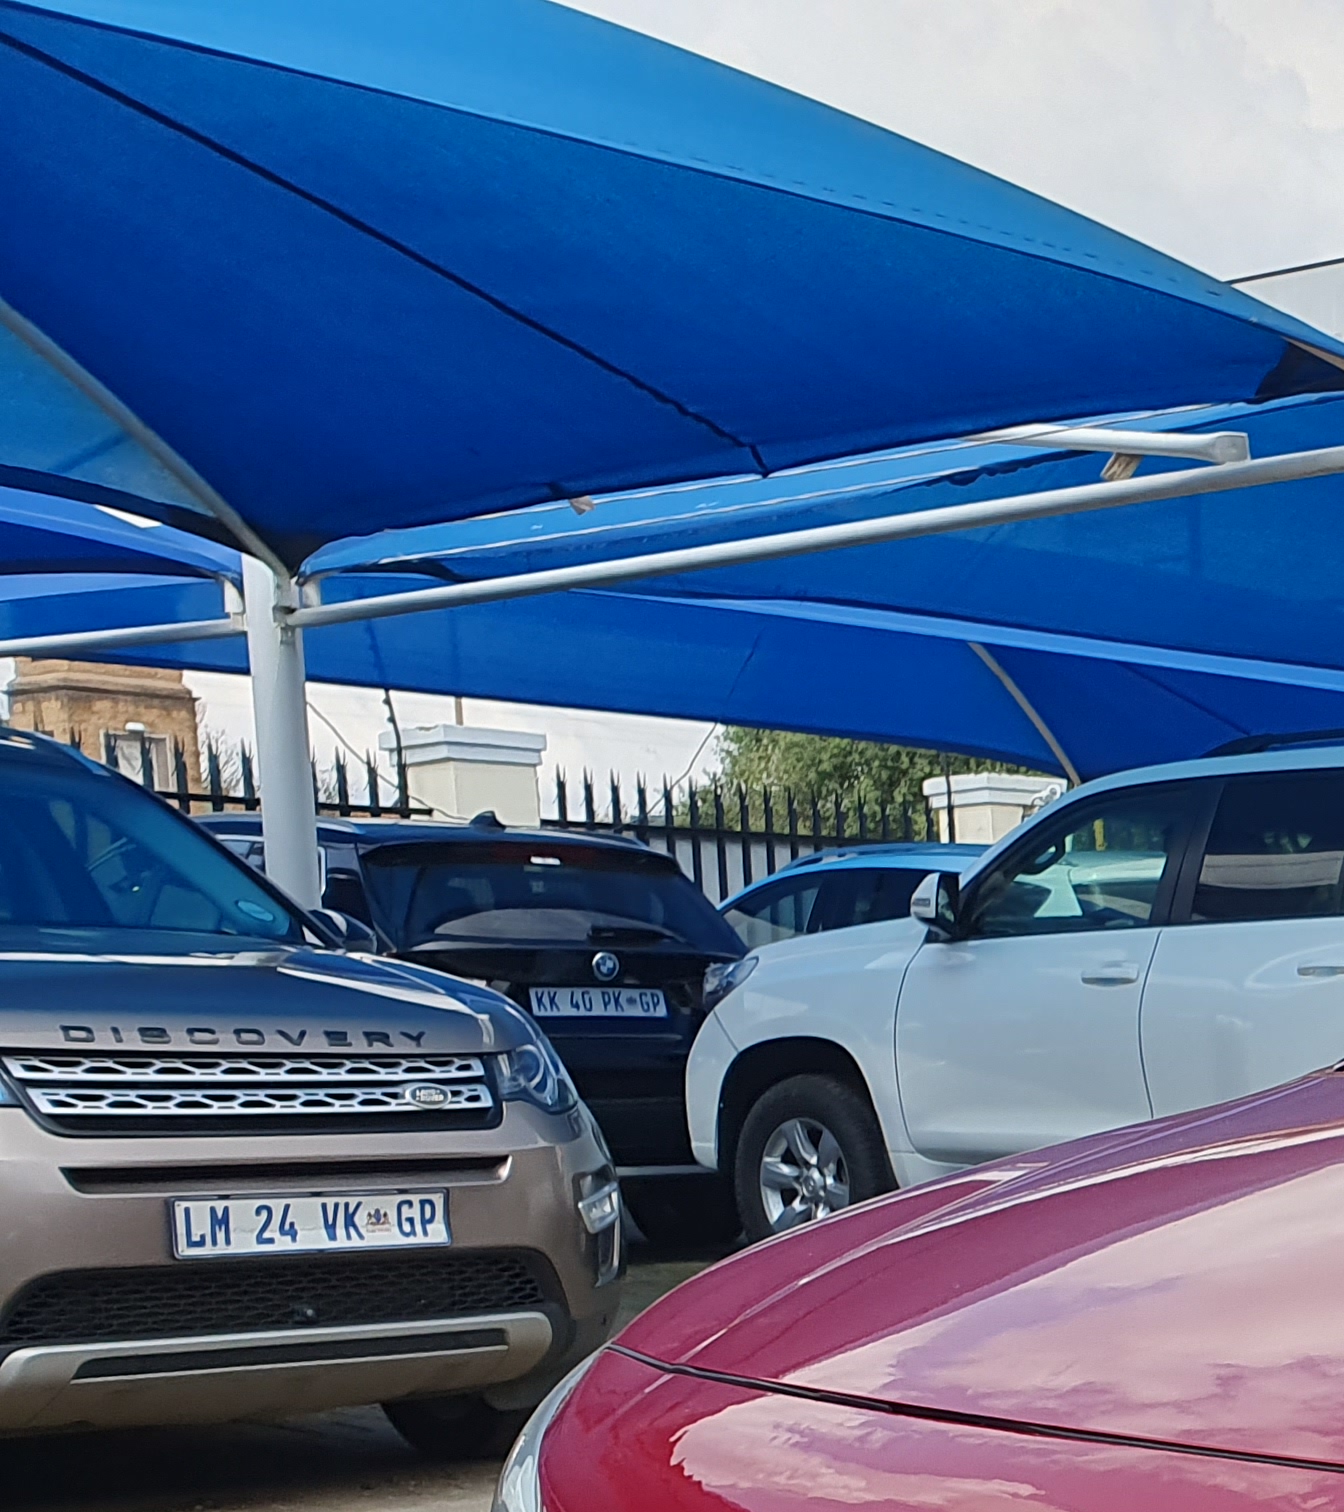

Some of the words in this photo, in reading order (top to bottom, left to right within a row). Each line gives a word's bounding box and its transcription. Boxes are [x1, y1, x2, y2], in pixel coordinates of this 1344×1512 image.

[535, 990, 560, 1012] KK
[570, 990, 593, 1012] 40
[601, 990, 624, 1012] PK
[639, 991, 660, 1013] GP
[59, 1024, 427, 1048] DISCOVERY
[184, 1205, 231, 1248] LM
[255, 1203, 298, 1245] 24
[320, 1200, 365, 1242] VK
[396, 1198, 436, 1238] GP
